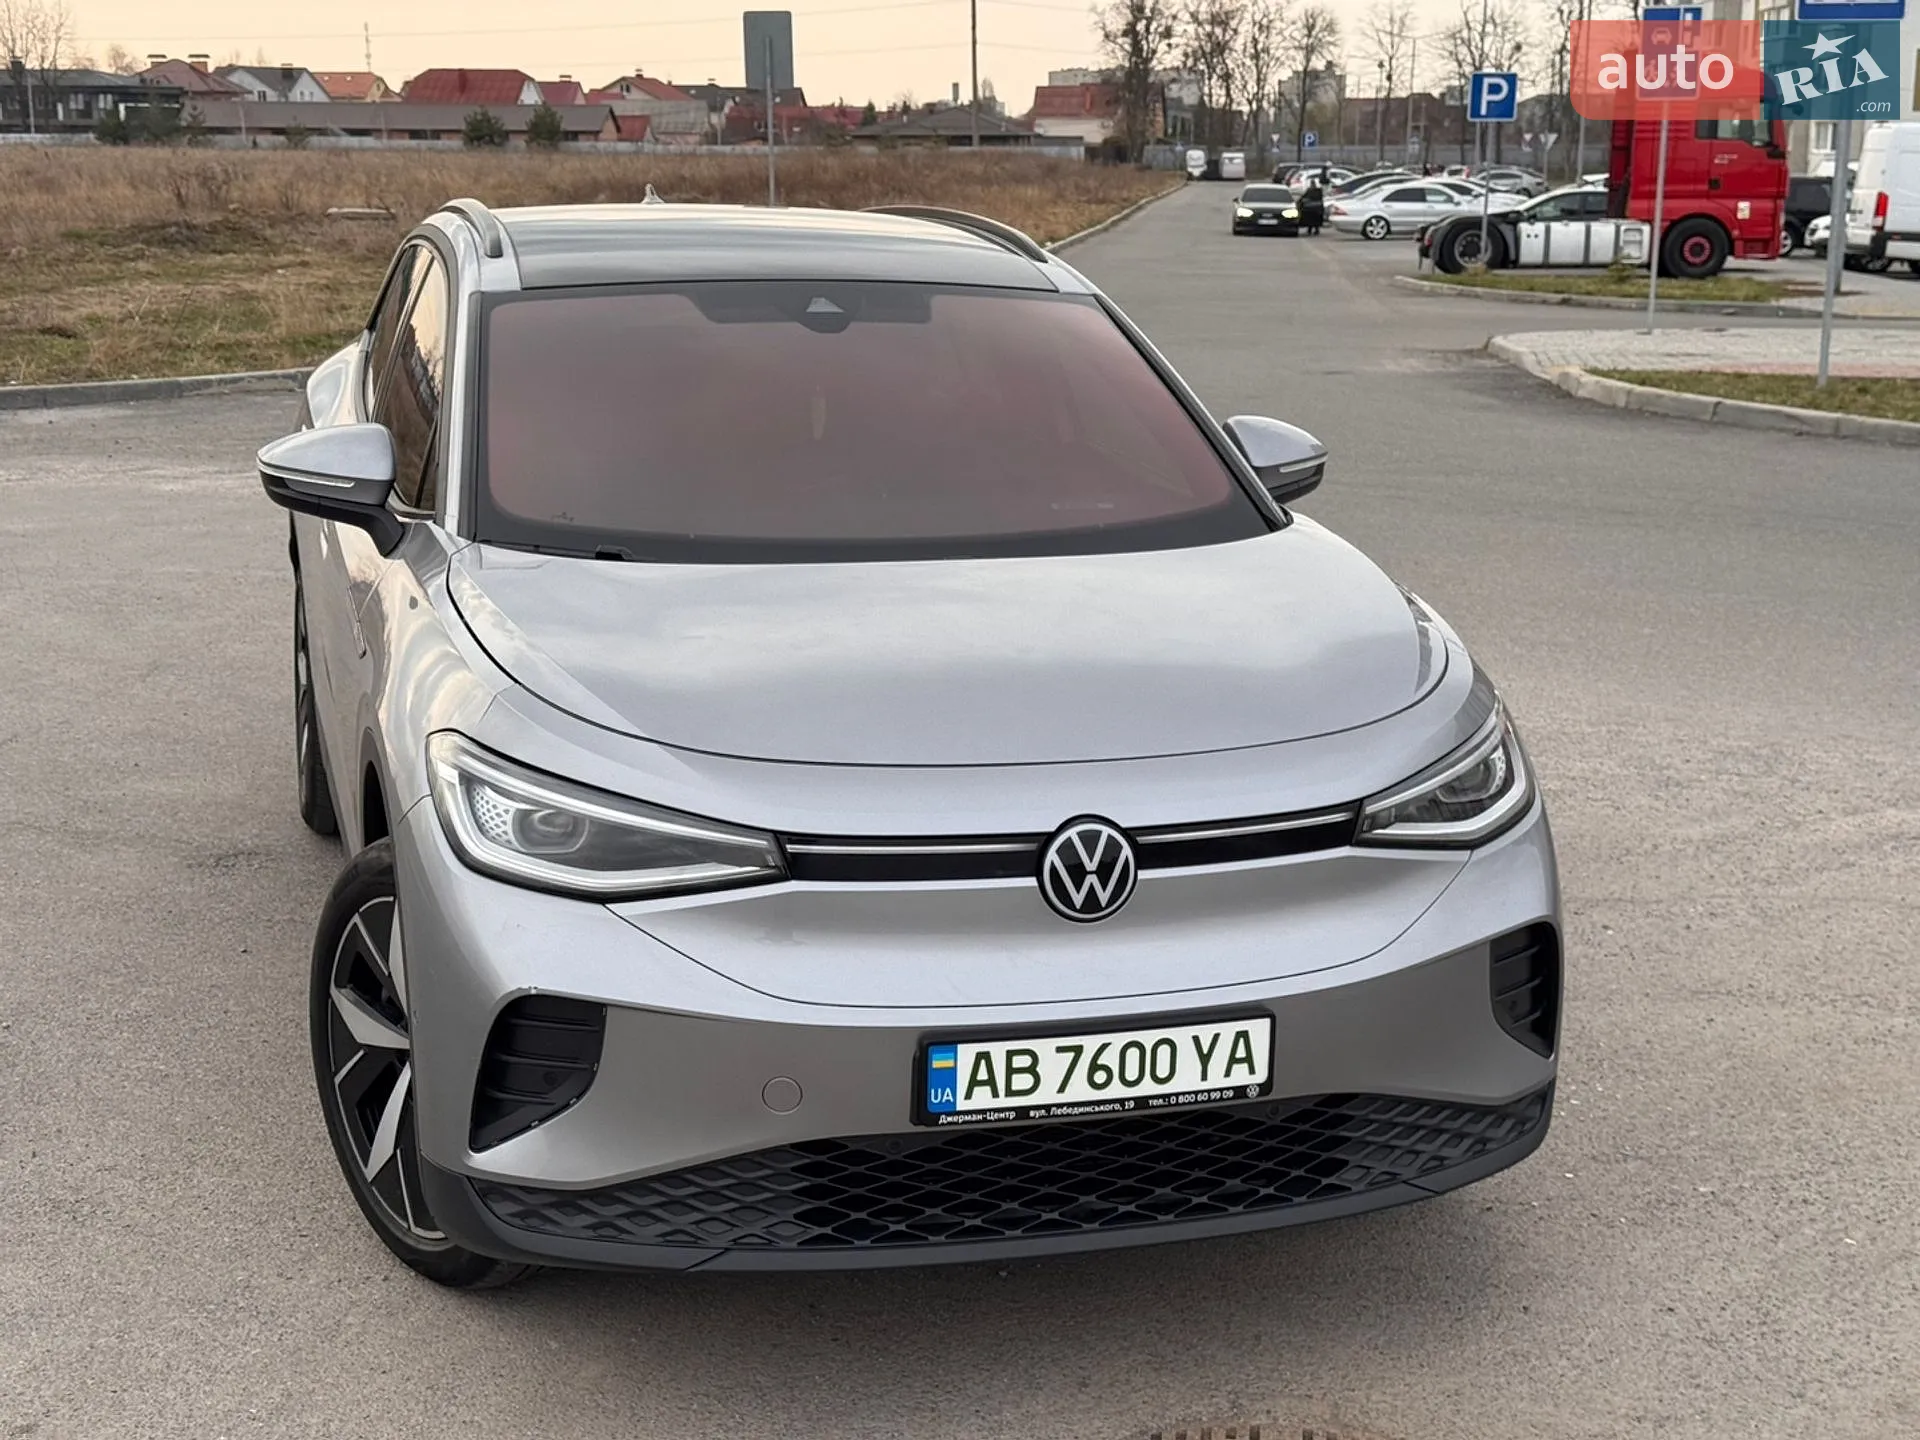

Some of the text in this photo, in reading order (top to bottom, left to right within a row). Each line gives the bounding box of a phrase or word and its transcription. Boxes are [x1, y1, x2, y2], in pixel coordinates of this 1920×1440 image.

[1480, 77, 1509, 116] P
[1304, 132, 1316, 148] P
[963, 1029, 1257, 1101] AB 7600 YA
[930, 1087, 954, 1104] UA
[938, 1110, 1017, 1125] Джерман-Центр
[1029, 1108, 1049, 1119] вул.
[1124, 1099, 1135, 1110] 19
[1169, 1095, 1177, 1105] 0
[1177, 1092, 1196, 1104] 800
[1196, 1091, 1209, 1102] 60
[1209, 1089, 1221, 1100] 99
[1221, 1088, 1234, 1099] 09
